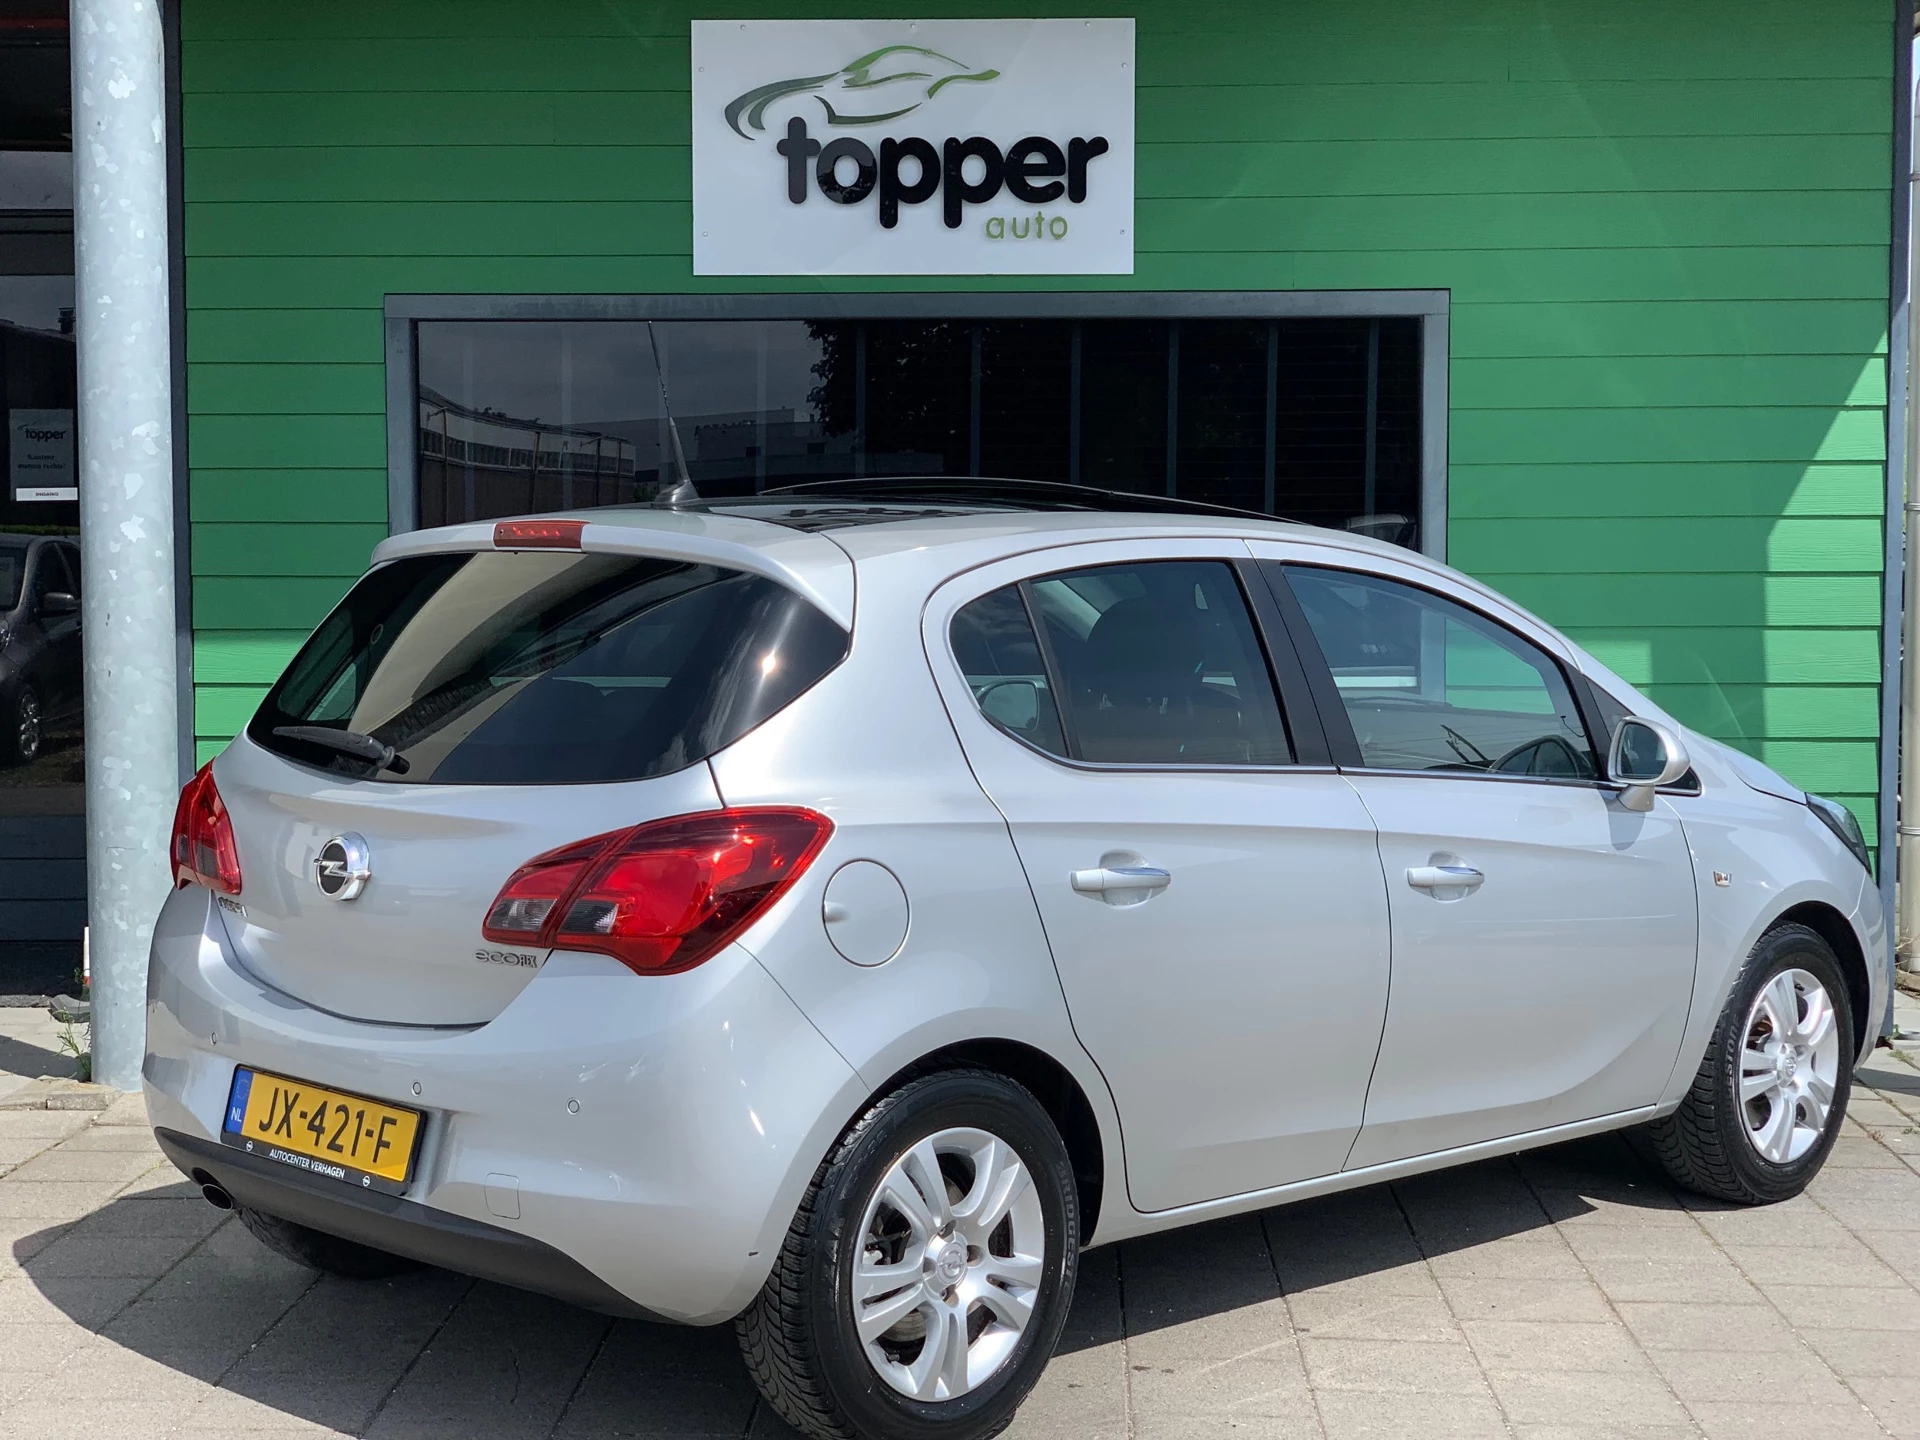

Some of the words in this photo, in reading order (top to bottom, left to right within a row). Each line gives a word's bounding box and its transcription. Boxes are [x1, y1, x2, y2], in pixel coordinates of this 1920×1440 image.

[776, 116, 1110, 230] topper
[985, 211, 1068, 240] auto
[25, 428, 67, 442] topper
[230, 1106, 243, 1124] NL
[258, 1087, 398, 1164] JX-421-F
[269, 1149, 310, 1168] AUTOCENTER
[310, 1160, 345, 1179] VERHAGEN
